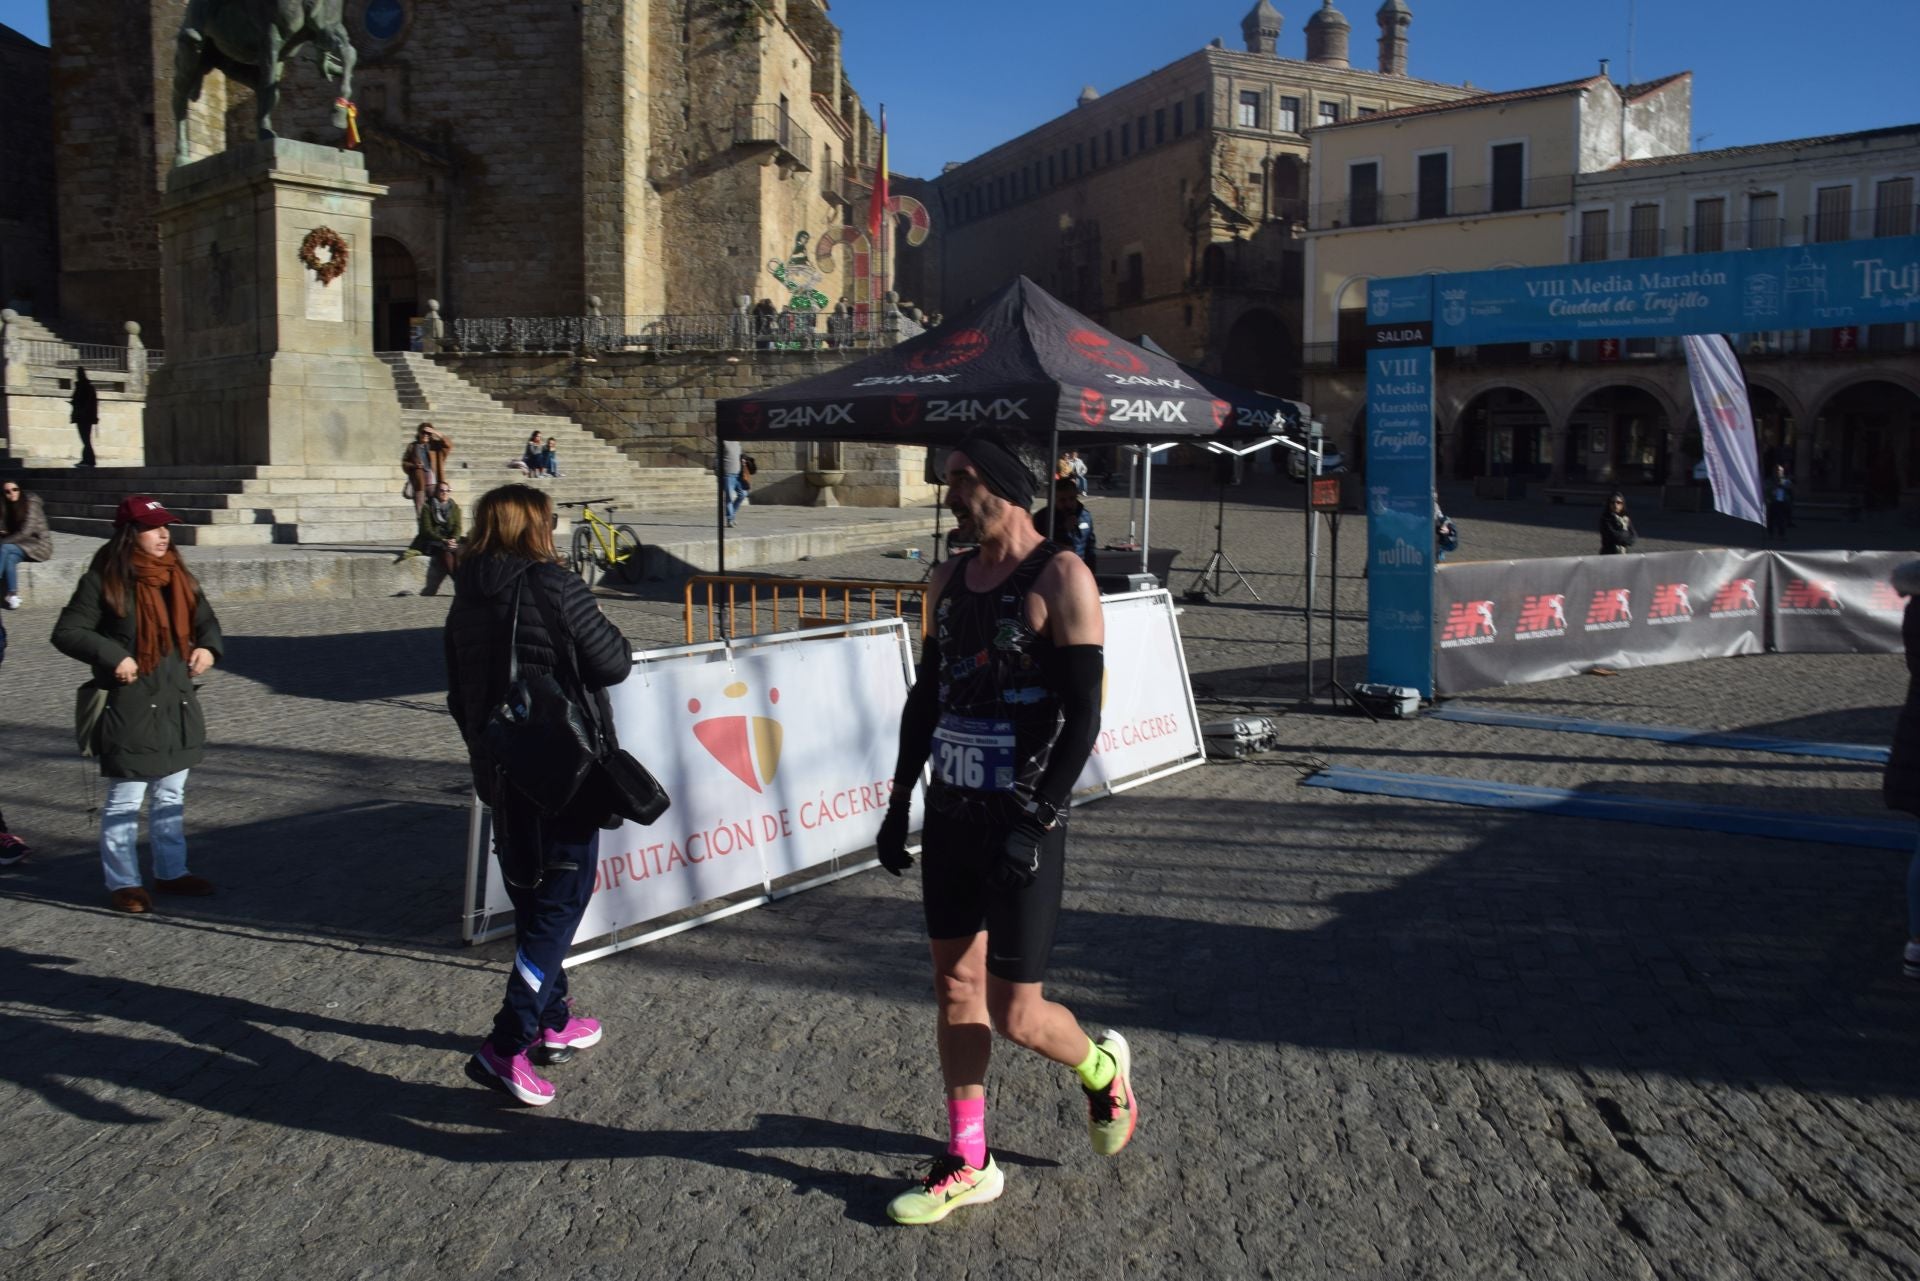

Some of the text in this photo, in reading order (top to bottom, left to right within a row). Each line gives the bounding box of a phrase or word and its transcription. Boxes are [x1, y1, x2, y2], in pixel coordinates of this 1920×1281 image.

[1526, 268, 1727, 298] VIII Media Maratón
[1548, 290, 1710, 317] Ciudad de Trujillo
[1376, 328, 1424, 343] SALIDA
[1377, 358, 1418, 377] VIII
[1105, 373, 1197, 390] 24MX
[1375, 382, 1426, 396] Media
[767, 402, 856, 429] 24MX
[924, 398, 1031, 422] 24MX
[1109, 398, 1188, 423] 24MX
[1372, 400, 1429, 414] Maratón
[1371, 429, 1428, 453] Trujillo
[1101, 729, 1120, 752] DE
[1121, 713, 1178, 746] CÁCERES
[939, 742, 985, 789] 216
[762, 808, 793, 843] DE
